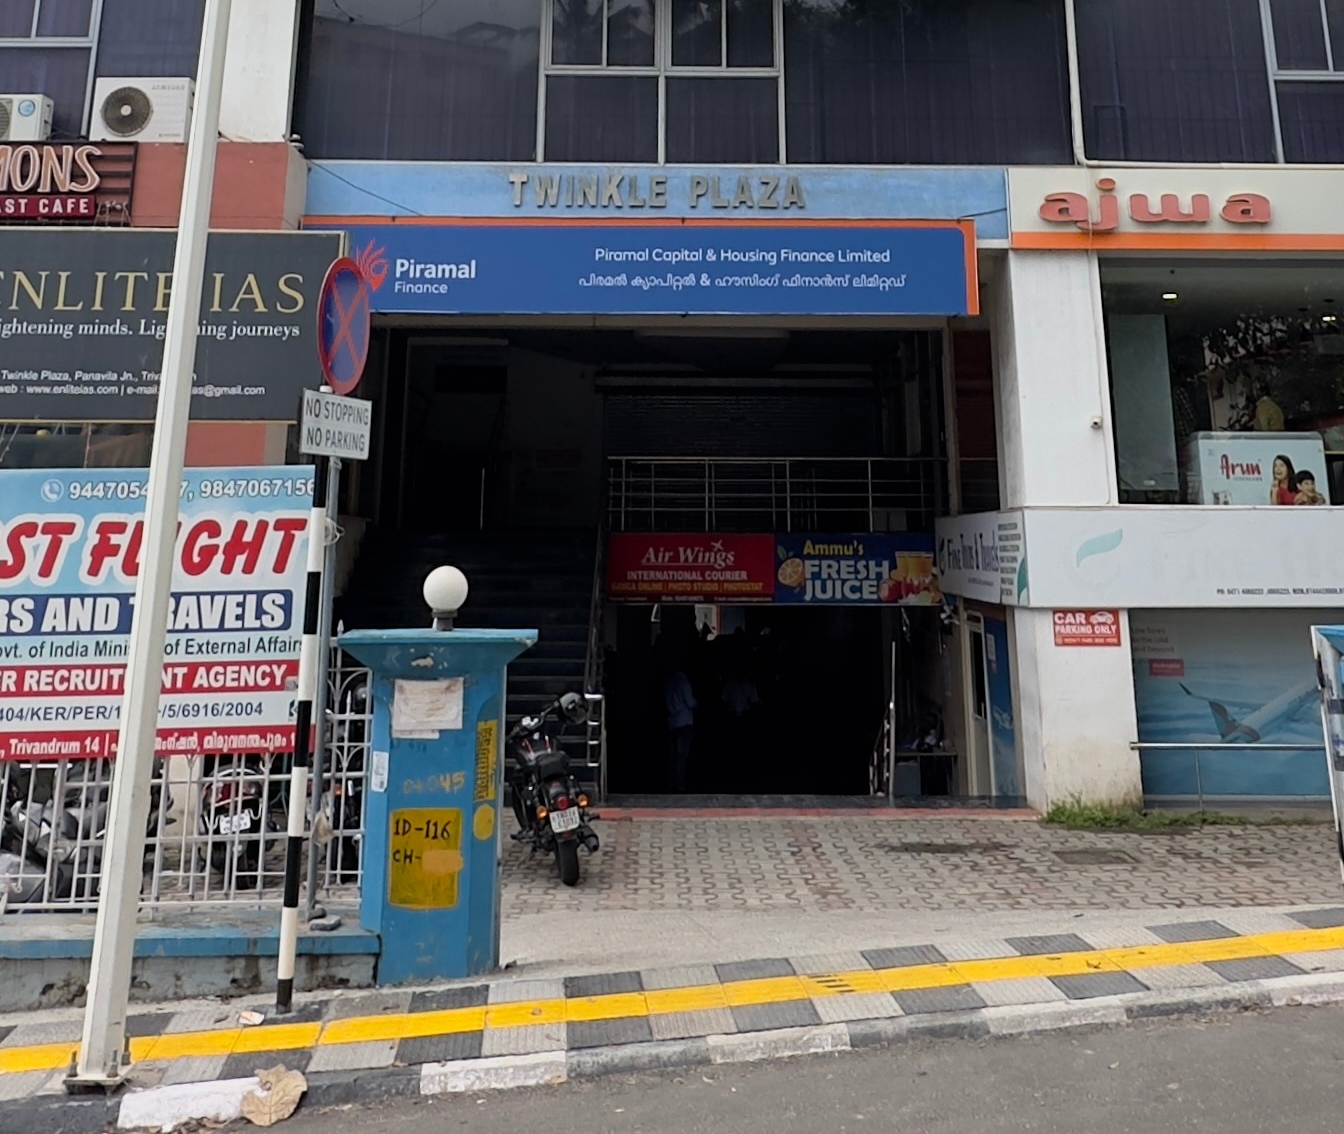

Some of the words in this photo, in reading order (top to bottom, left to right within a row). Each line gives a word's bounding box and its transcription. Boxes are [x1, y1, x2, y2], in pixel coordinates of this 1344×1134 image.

[509, 172, 667, 207] TWINKLE
[689, 174, 805, 209] PLAZA
[38, 197, 89, 214] CAFE
[1039, 177, 1273, 232] ajwa
[595, 248, 649, 262] Piramal
[652, 248, 703, 265] Capital
[705, 249, 717, 262] &
[720, 248, 777, 266] Housing
[780, 248, 835, 263] Finance
[838, 249, 891, 263] Limited
[395, 258, 476, 279] Piramal
[394, 280, 448, 294] Finance
[699, 274, 711, 287] &
[209, 272, 306, 313] IAS
[78, 319, 133, 336] minds.
[229, 321, 300, 340] journeys
[1, 370, 39, 380] Twinkle
[40, 370, 72, 382] Plaza,
[305, 397, 321, 418] NO
[323, 400, 369, 426] STOPPING
[306, 426, 322, 447] NO
[325, 429, 366, 452] PARKING
[1219, 453, 1262, 480] Arun
[641, 546, 674, 564] Air
[677, 546, 736, 569] Wings
[803, 539, 864, 556] Ammu's
[627, 570, 703, 581] INTERNATIONAL
[705, 570, 748, 581] COURIER
[804, 559, 890, 580] FRESH
[668, 582, 692, 591] PHOTO
[693, 582, 720, 591] STUDIO
[804, 579, 879, 602] JUICE
[40, 596, 121, 634] AND
[1054, 612, 1087, 625] CAR
[1055, 624, 1093, 635] PARKING
[1094, 624, 1117, 635] ONLY
[28, 641, 46, 659] of
[49, 640, 89, 658] India
[163, 638, 182, 656] of
[185, 637, 251, 655] External
[192, 664, 288, 688] AGENCY
[8, 737, 81, 756] Trivandrum
[84, 736, 101, 754] 14
